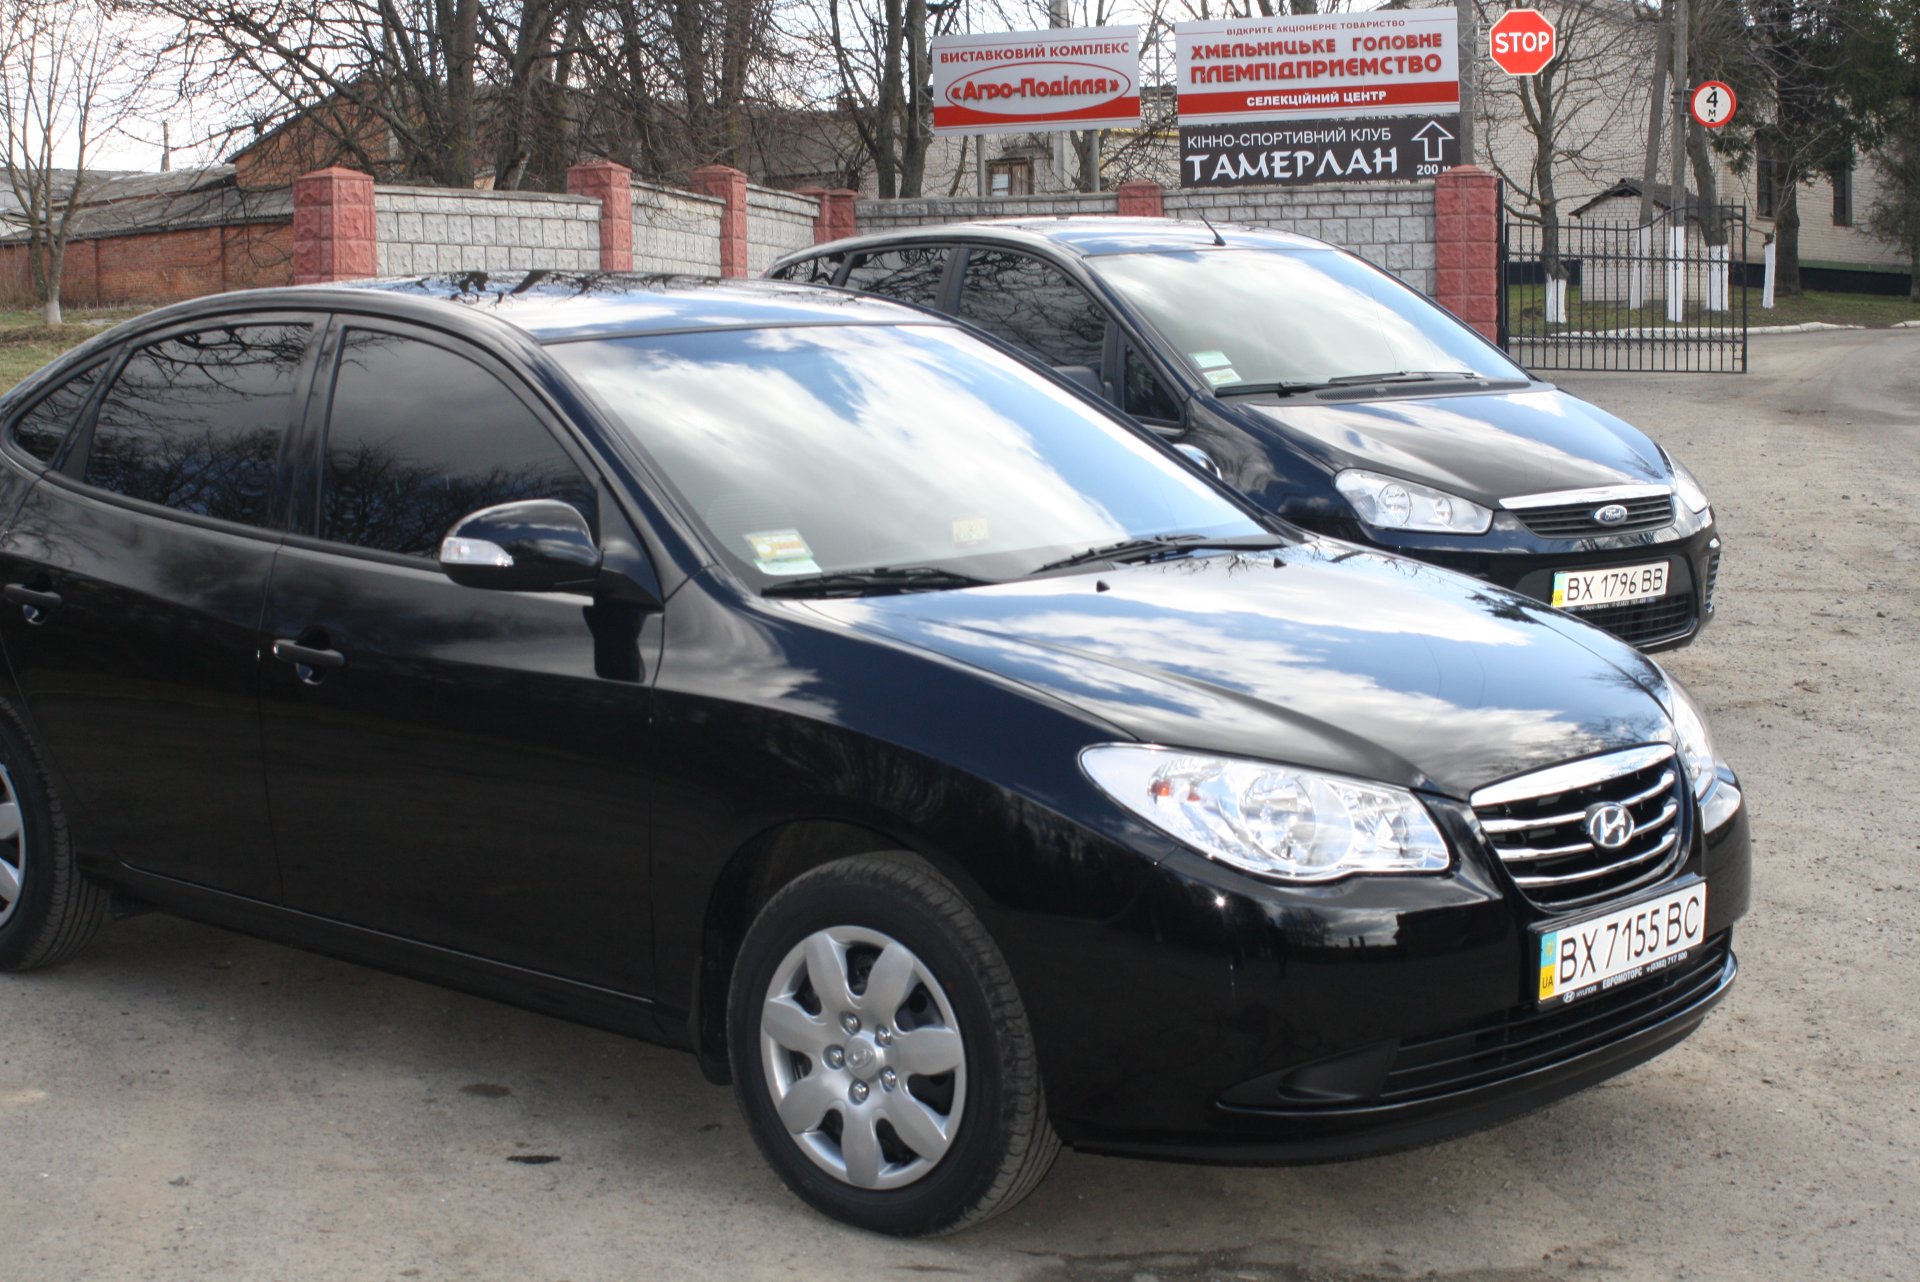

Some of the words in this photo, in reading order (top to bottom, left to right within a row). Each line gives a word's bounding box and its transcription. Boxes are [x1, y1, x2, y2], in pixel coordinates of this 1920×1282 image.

[1226, 26, 1273, 36] ВІДКРИТЕ
[1276, 23, 1337, 34] АКЦІОНЕРНЕ
[1340, 20, 1405, 30] ТОВАРИСТВО
[940, 44, 1046, 64] ВИСТАВКОВИЙ
[1050, 42, 1129, 57] КОМПЛЕКС
[1191, 38, 1336, 60] ХМЕЛЬНИЦЬКЕ
[1352, 33, 1442, 52] ГОЛОВНЕ
[1495, 31, 1550, 53] STOP
[1190, 53, 1442, 84] ПЛЕМПІДПРИЄМСТВО
[1247, 92, 1339, 106] СЕЛЕКЦІЙНИЙ
[1344, 91, 1387, 104] ЦЕНТР
[1706, 91, 1718, 108] 4
[1187, 127, 1346, 149] КІННО-СПОРТИВНИЙ
[1350, 127, 1391, 142] КЛУБ
[1185, 146, 1398, 182] ТАМЕРЛАН
[1416, 164, 1438, 175] 200
[1601, 571, 1637, 598] 1796
[1604, 908, 1660, 969] 7155
[1542, 974, 1554, 989] UA
